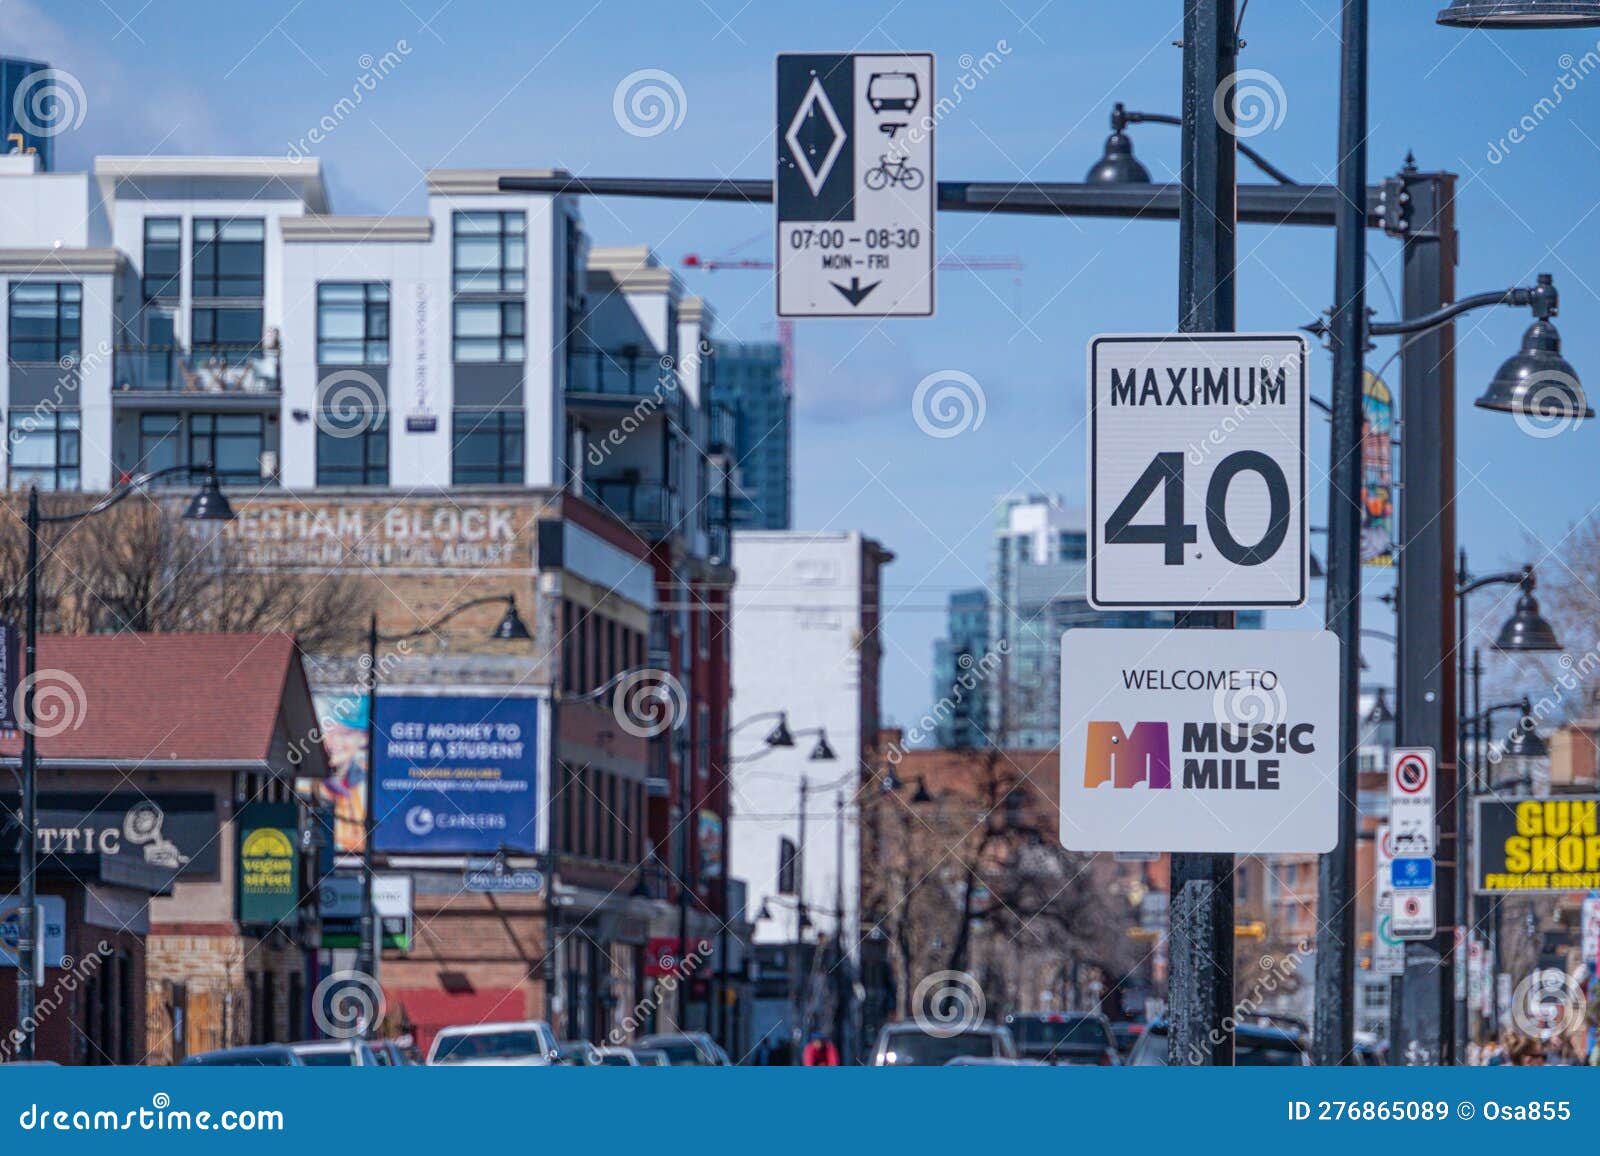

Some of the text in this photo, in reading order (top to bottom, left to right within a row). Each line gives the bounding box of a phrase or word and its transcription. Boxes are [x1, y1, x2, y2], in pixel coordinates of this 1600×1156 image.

[791, 229, 844, 249] 07:00
[866, 229, 920, 249] 08:30
[1110, 366, 1287, 407] MAXIMUM
[384, 507, 516, 541] BLOCK
[1104, 450, 1290, 567] 40
[1122, 669, 1278, 691] WELCOME TO
[390, 722, 521, 740] GET MONEY TO
[1182, 722, 1315, 754] MUSIC
[388, 742, 524, 759] HIRE A STUDENT
[1183, 759, 1280, 790] MILE
[1516, 801, 1597, 837] GUN
[15, 828, 120, 854] TTIC
